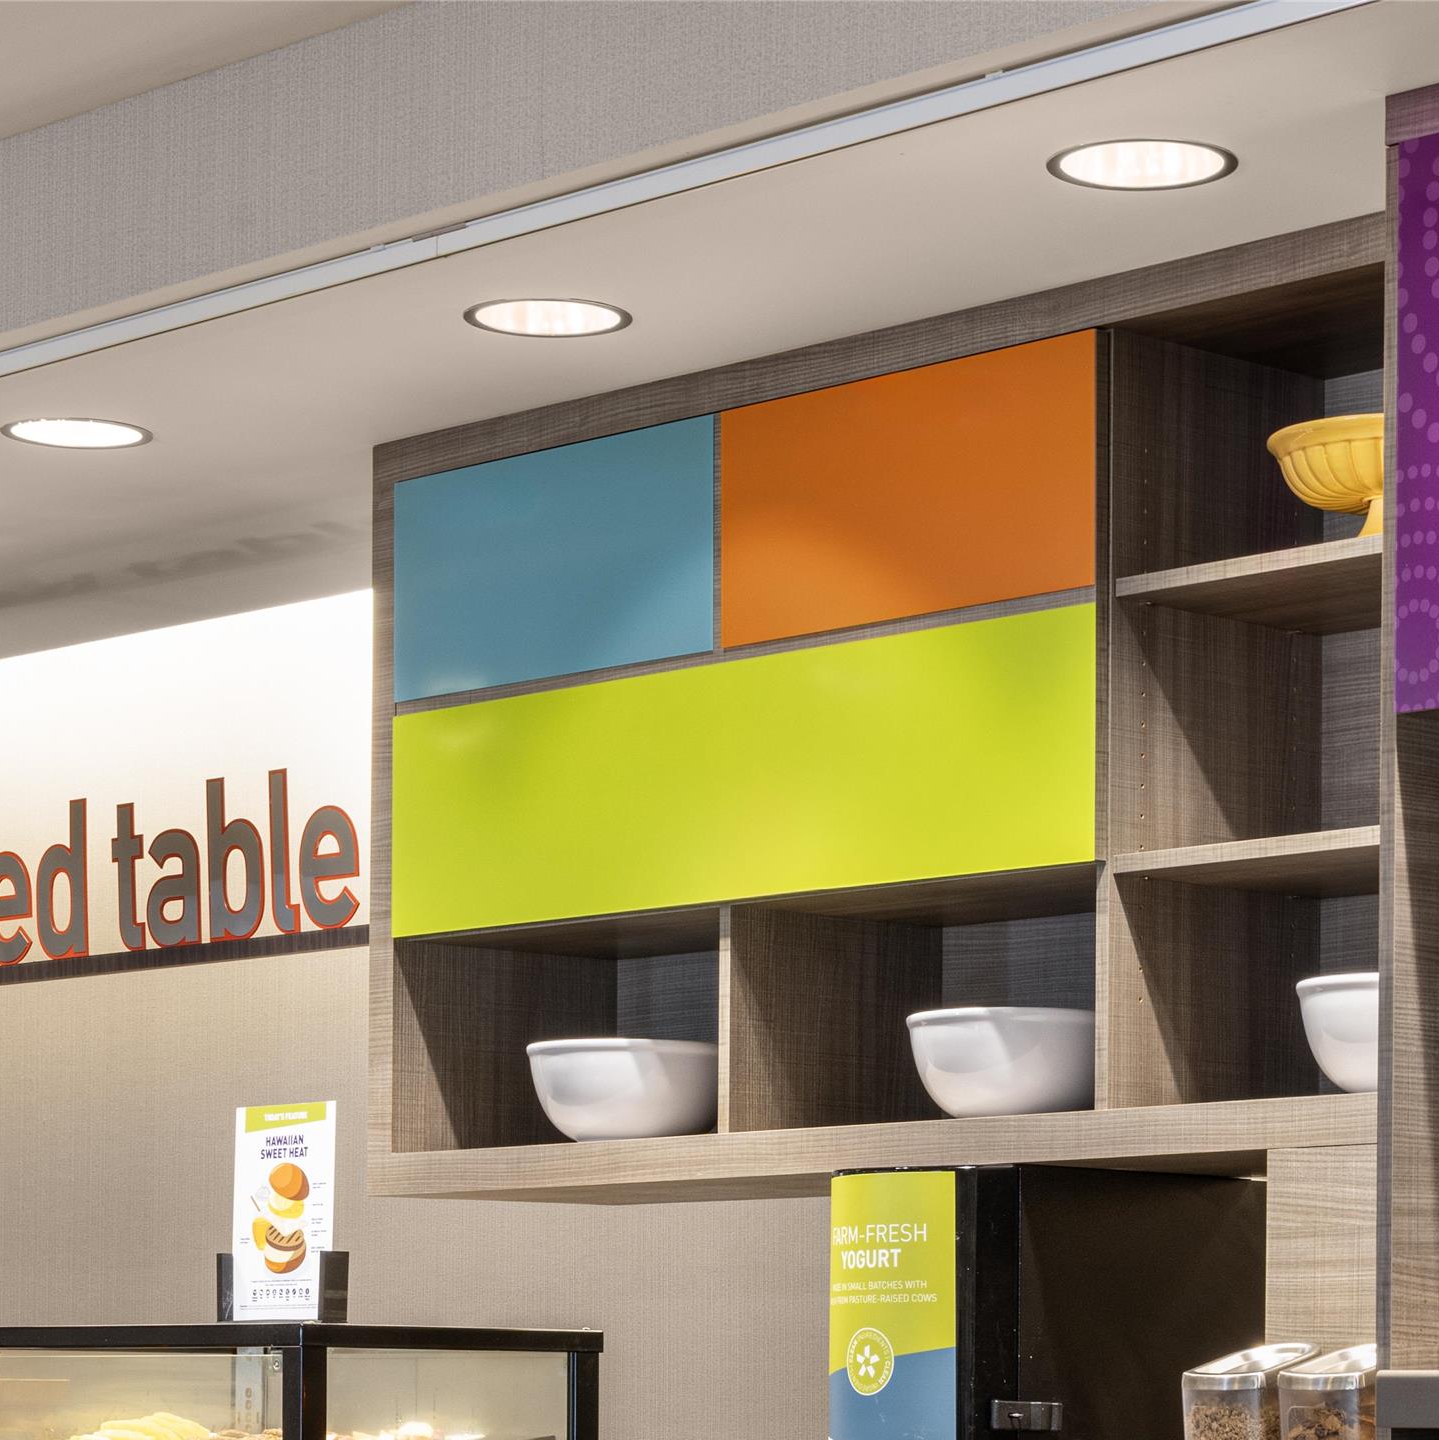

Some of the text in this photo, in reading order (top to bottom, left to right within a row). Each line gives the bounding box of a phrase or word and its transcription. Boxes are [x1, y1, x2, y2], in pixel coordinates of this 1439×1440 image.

[112, 768, 360, 952] table
[265, 1134, 304, 1147] HAWAIIAN
[260, 1146, 309, 1160] SWEET HEAT
[832, 1223, 928, 1246] FARM-FRESH
[841, 1248, 902, 1270] YOGURT
[868, 1280, 903, 1290] BATCHES
[905, 1279, 928, 1289] WITH
[848, 1293, 910, 1305] PASTURE-RAISED
[911, 1292, 938, 1303] COWS
